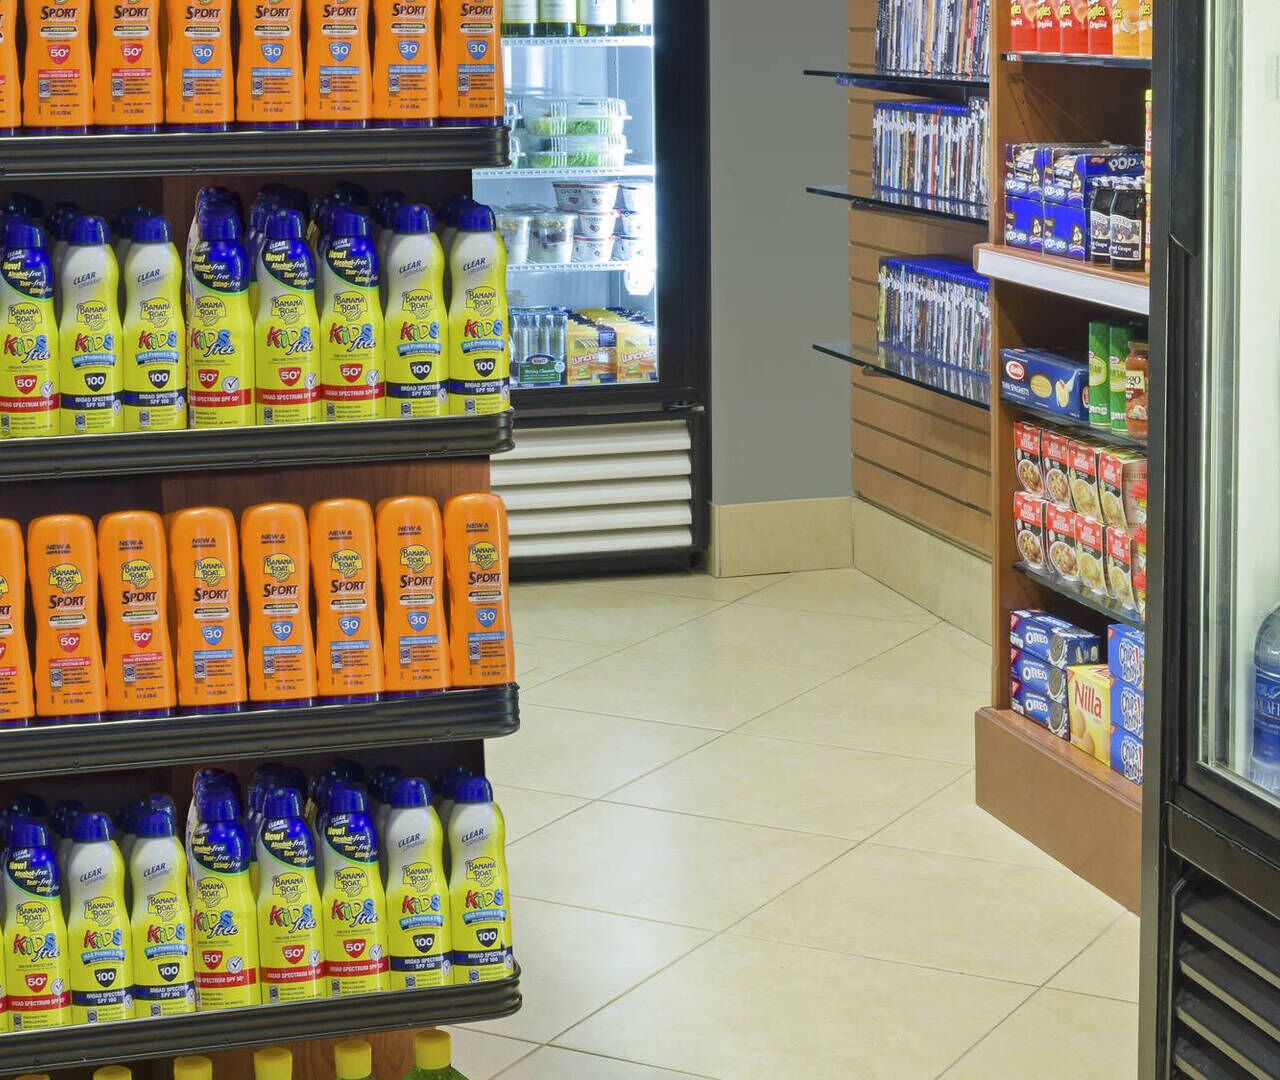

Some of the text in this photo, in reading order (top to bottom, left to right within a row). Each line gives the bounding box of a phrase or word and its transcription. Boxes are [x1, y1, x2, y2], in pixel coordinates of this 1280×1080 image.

[40, 6, 77, 21] SPORT
[185, 6, 221, 20] SPORT
[323, 4, 358, 18] SPORT
[460, 3, 494, 17] SPORT
[195, 48, 212, 57] 30
[331, 45, 348, 55] 30
[469, 44, 486, 53] 30
[399, 260, 422, 274] CLEAR
[412, 364, 430, 375] 100
[193, 587, 229, 602] SPORT
[205, 629, 222, 639] 30
[1025, 631, 1048, 645] OREO
[1022, 667, 1047, 681] OREO
[1025, 698, 1048, 712] OREO
[1074, 680, 1102, 719] Nilla
[415, 937, 433, 947] 100
